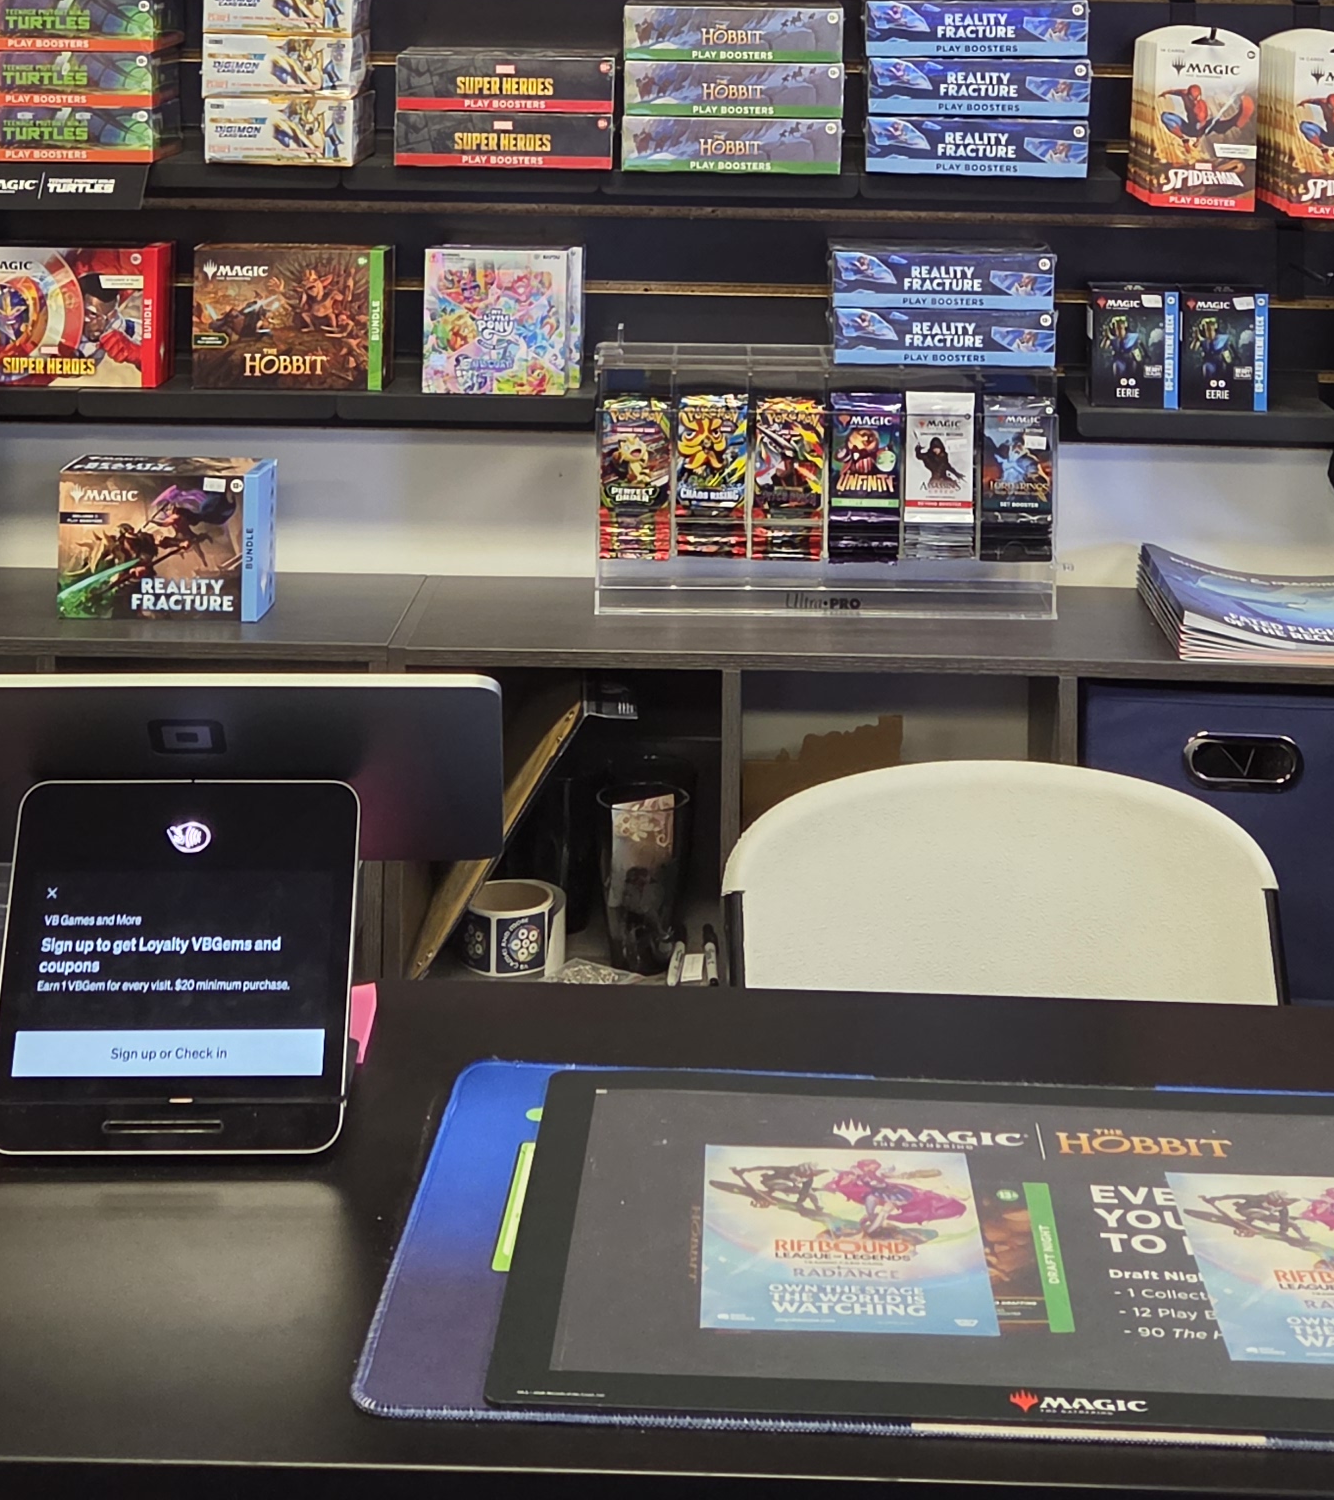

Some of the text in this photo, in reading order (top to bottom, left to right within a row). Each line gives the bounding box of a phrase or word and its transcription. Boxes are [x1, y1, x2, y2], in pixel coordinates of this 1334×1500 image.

[1186, 62, 1240, 76] MAGIC
[1162, 168, 1244, 191] SPIDER-MAN
[1169, 196, 1236, 207] PLAY BOOSTER
[1116, 388, 1140, 398] EERIE
[836, 470, 896, 492] UNFINITY
[44, 915, 142, 926] VB Games and More
[41, 937, 281, 955] Sign up to get Loyalty VBGems and
[39, 960, 100, 976] coupons
[37, 979, 290, 993] Earn 1 VBGem for every visit. $20 minimum purchase.
[111, 1047, 227, 1062] Sign up or Check in
[870, 1128, 1024, 1148] MAGIC
[1094, 1128, 1124, 1136] THE
[1056, 1131, 1232, 1158] HOBBIT
[774, 1239, 910, 1255] RIFTBOUND
[1039, 1224, 1060, 1285] DRAFT NIGHT
[772, 1301, 927, 1317] WATCHING
